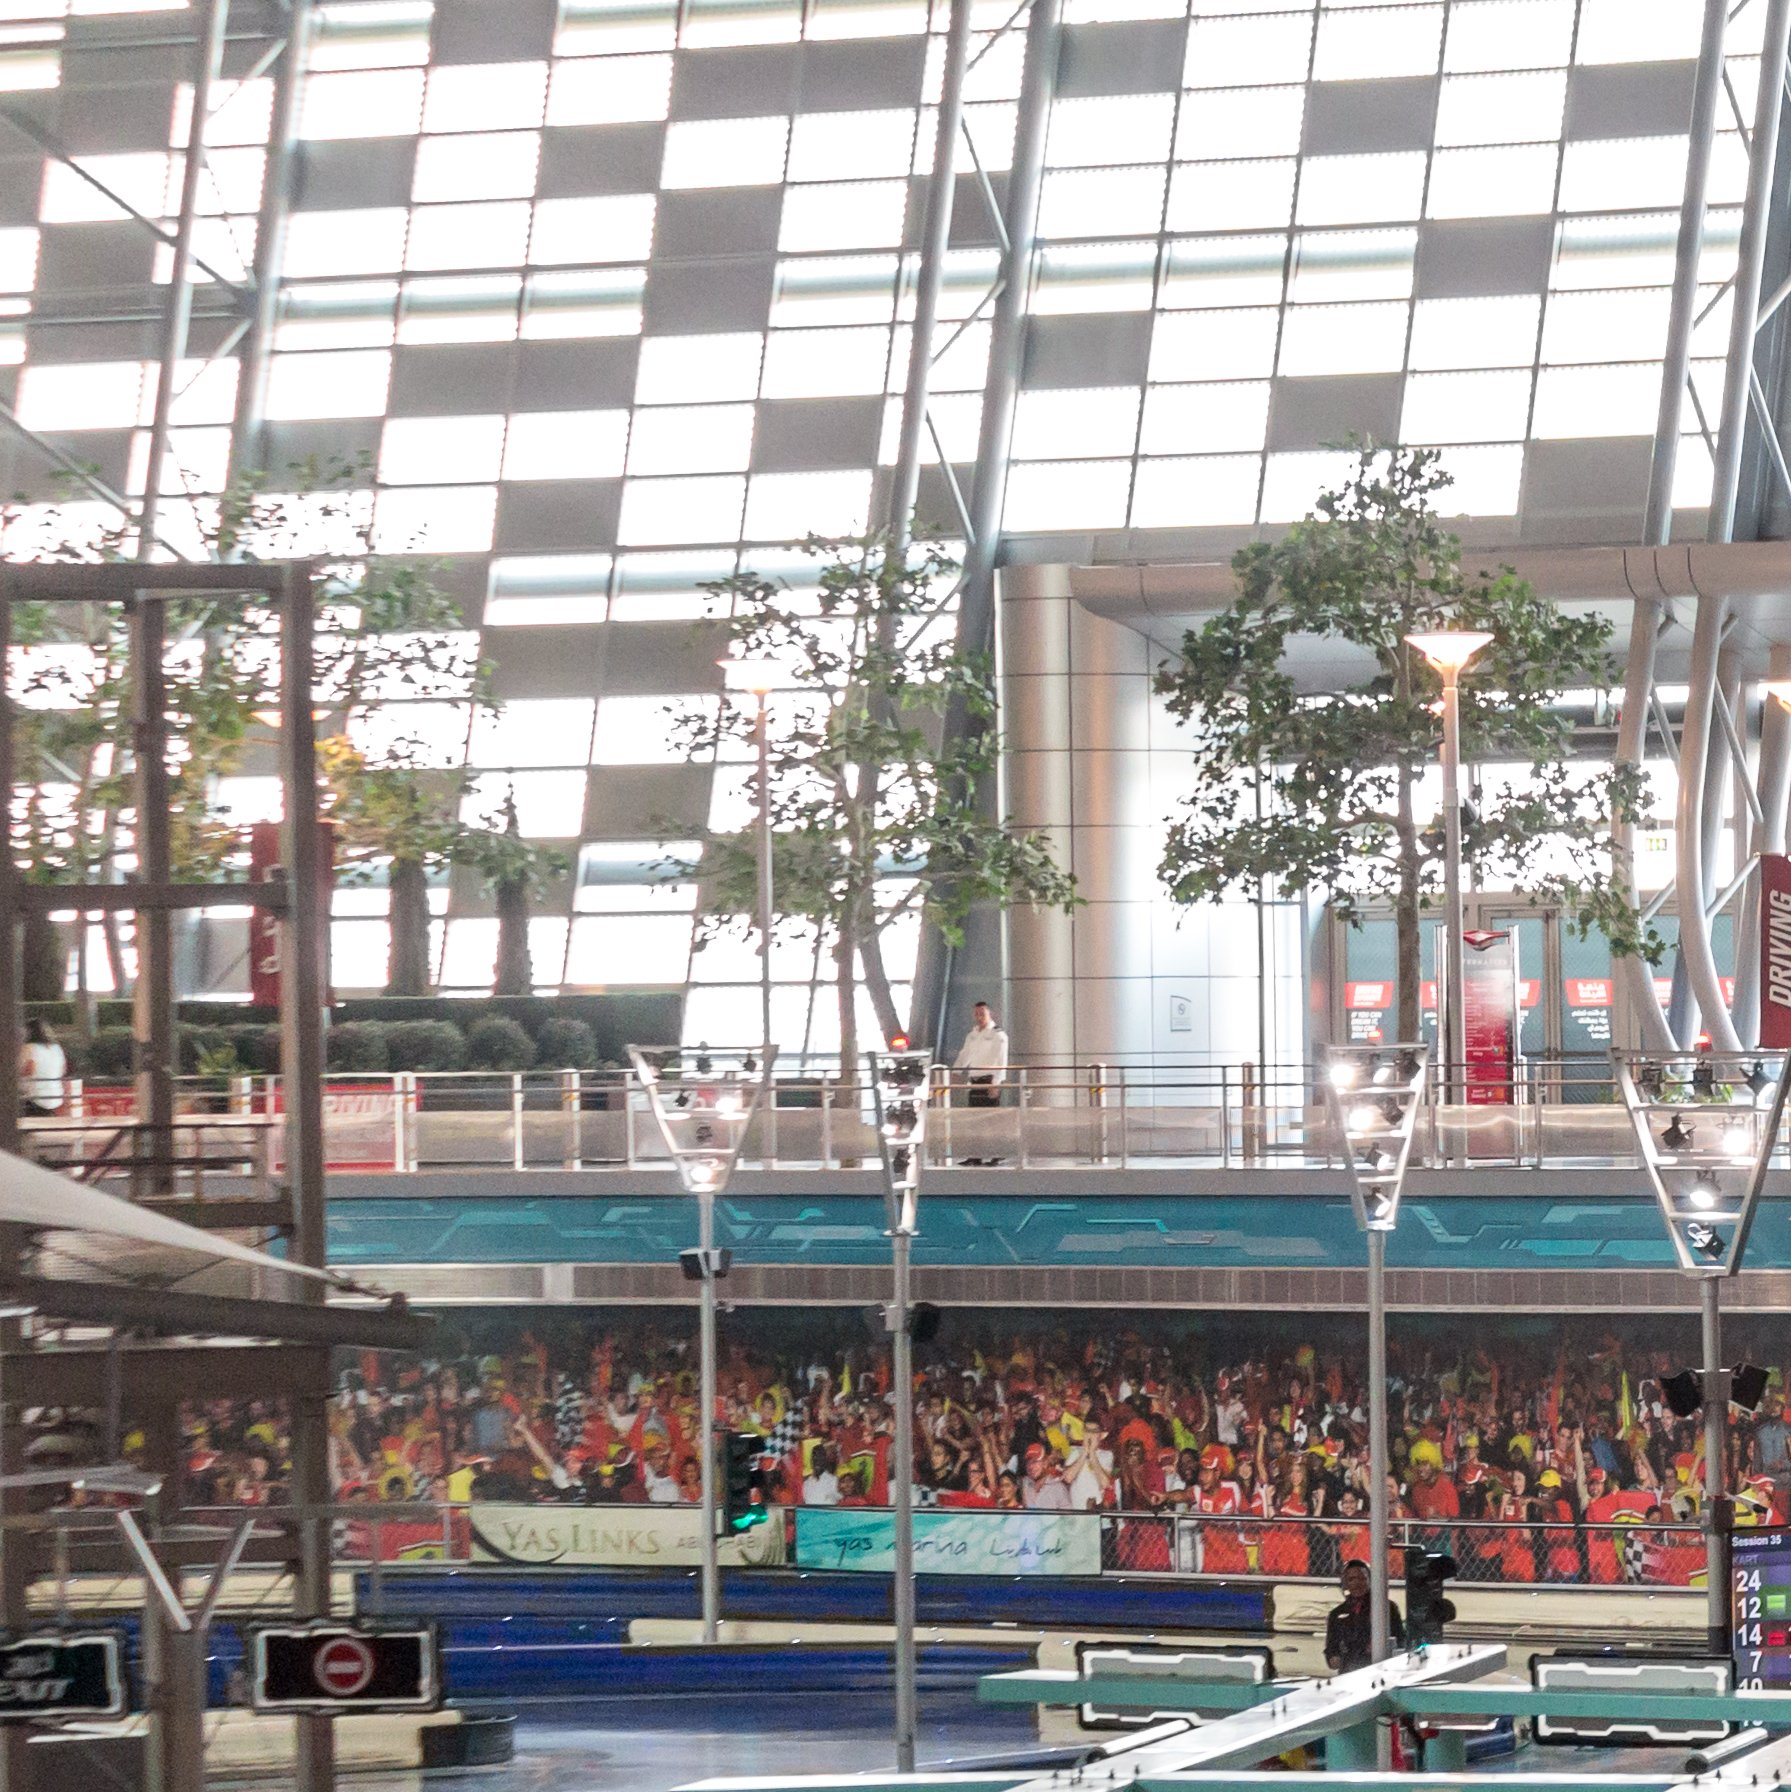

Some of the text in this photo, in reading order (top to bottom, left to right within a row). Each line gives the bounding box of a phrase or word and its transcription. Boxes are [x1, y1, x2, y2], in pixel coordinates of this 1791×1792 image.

[502, 1522, 560, 1551] YAS
[571, 1523, 660, 1555] LINKS
[1731, 1536, 1768, 1547] Session
[1770, 1535, 1782, 1545] 35
[1736, 1570, 1761, 1592] 24
[1737, 1597, 1761, 1619] 12
[1738, 1623, 1762, 1646] 14
[1750, 1651, 1763, 1672] 7
